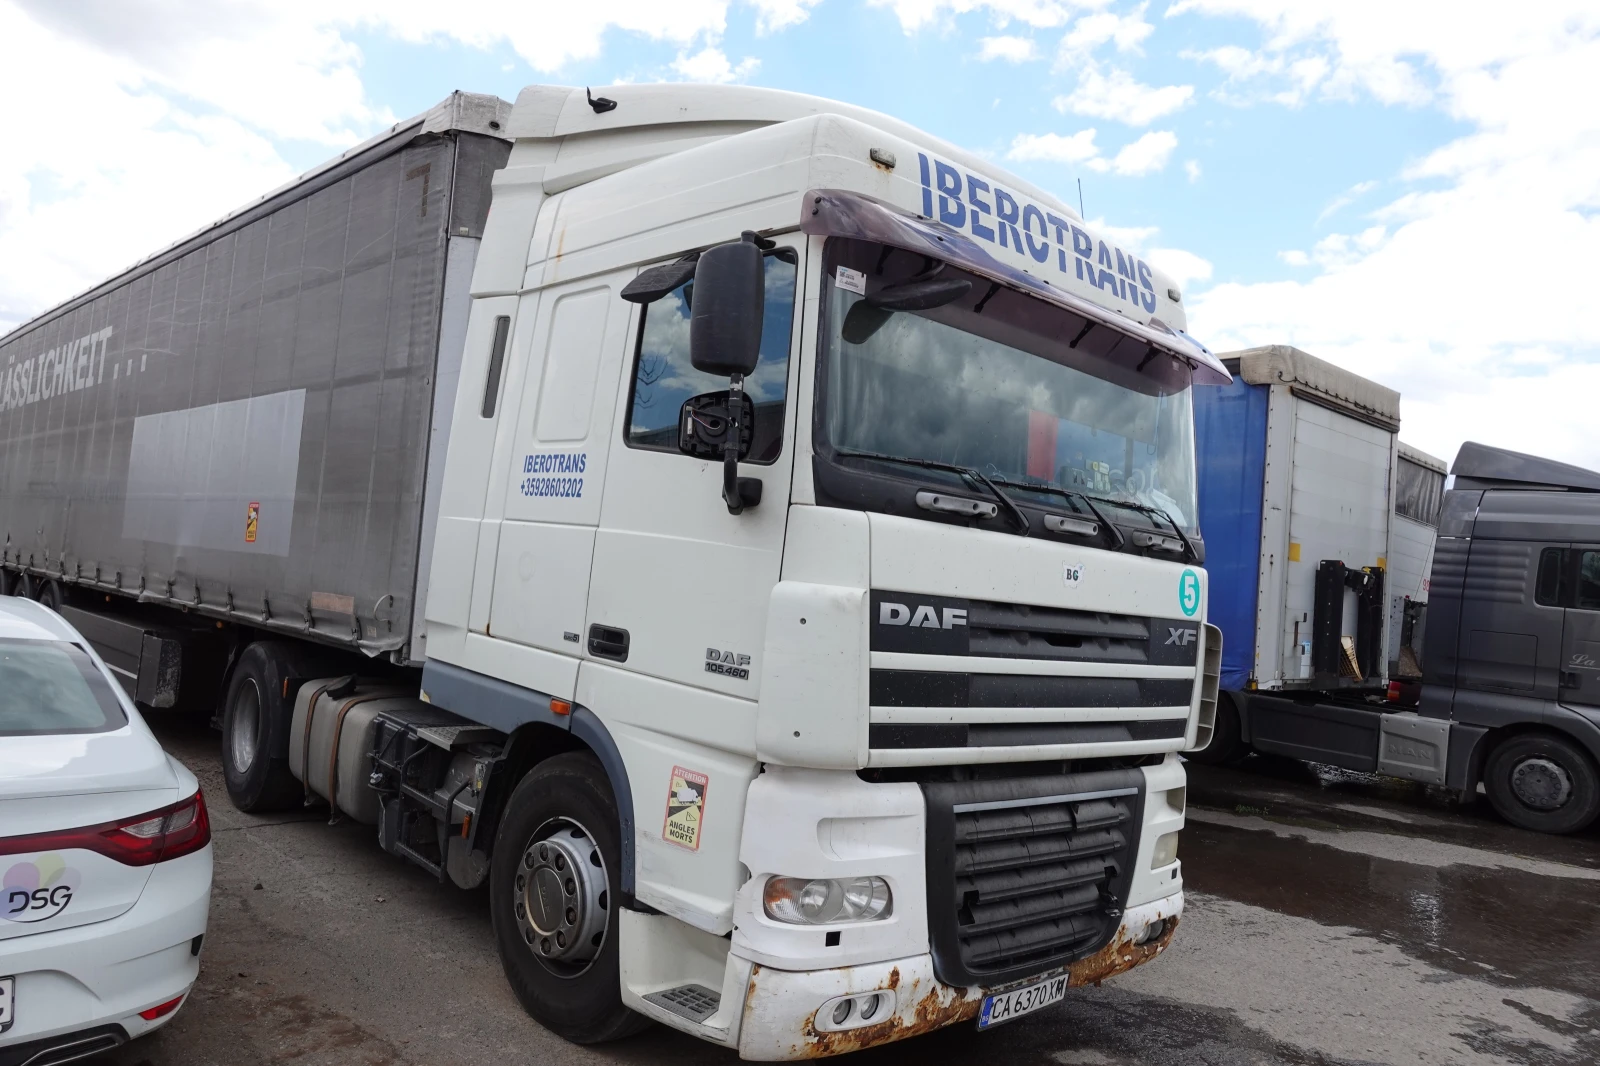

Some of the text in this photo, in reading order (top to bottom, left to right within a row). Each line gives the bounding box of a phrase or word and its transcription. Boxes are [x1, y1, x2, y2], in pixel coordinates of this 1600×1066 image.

[918, 152, 1157, 314] IBEROTRANS
[523, 453, 587, 474] IBEROTRANS
[521, 477, 584, 498] +35928603202
[1066, 568, 1079, 581] BG
[1183, 576, 1196, 609] 5
[879, 601, 968, 630] DAF
[1164, 627, 1197, 646] XF
[705, 647, 751, 667] DAF
[674, 768, 707, 784] ATTENTION
[669, 820, 695, 836] ANGLES
[669, 829, 693, 844] MORTS
[8, 885, 73, 922] DSG
[992, 995, 1010, 1020] CA
[1014, 984, 1047, 1014] 6370
